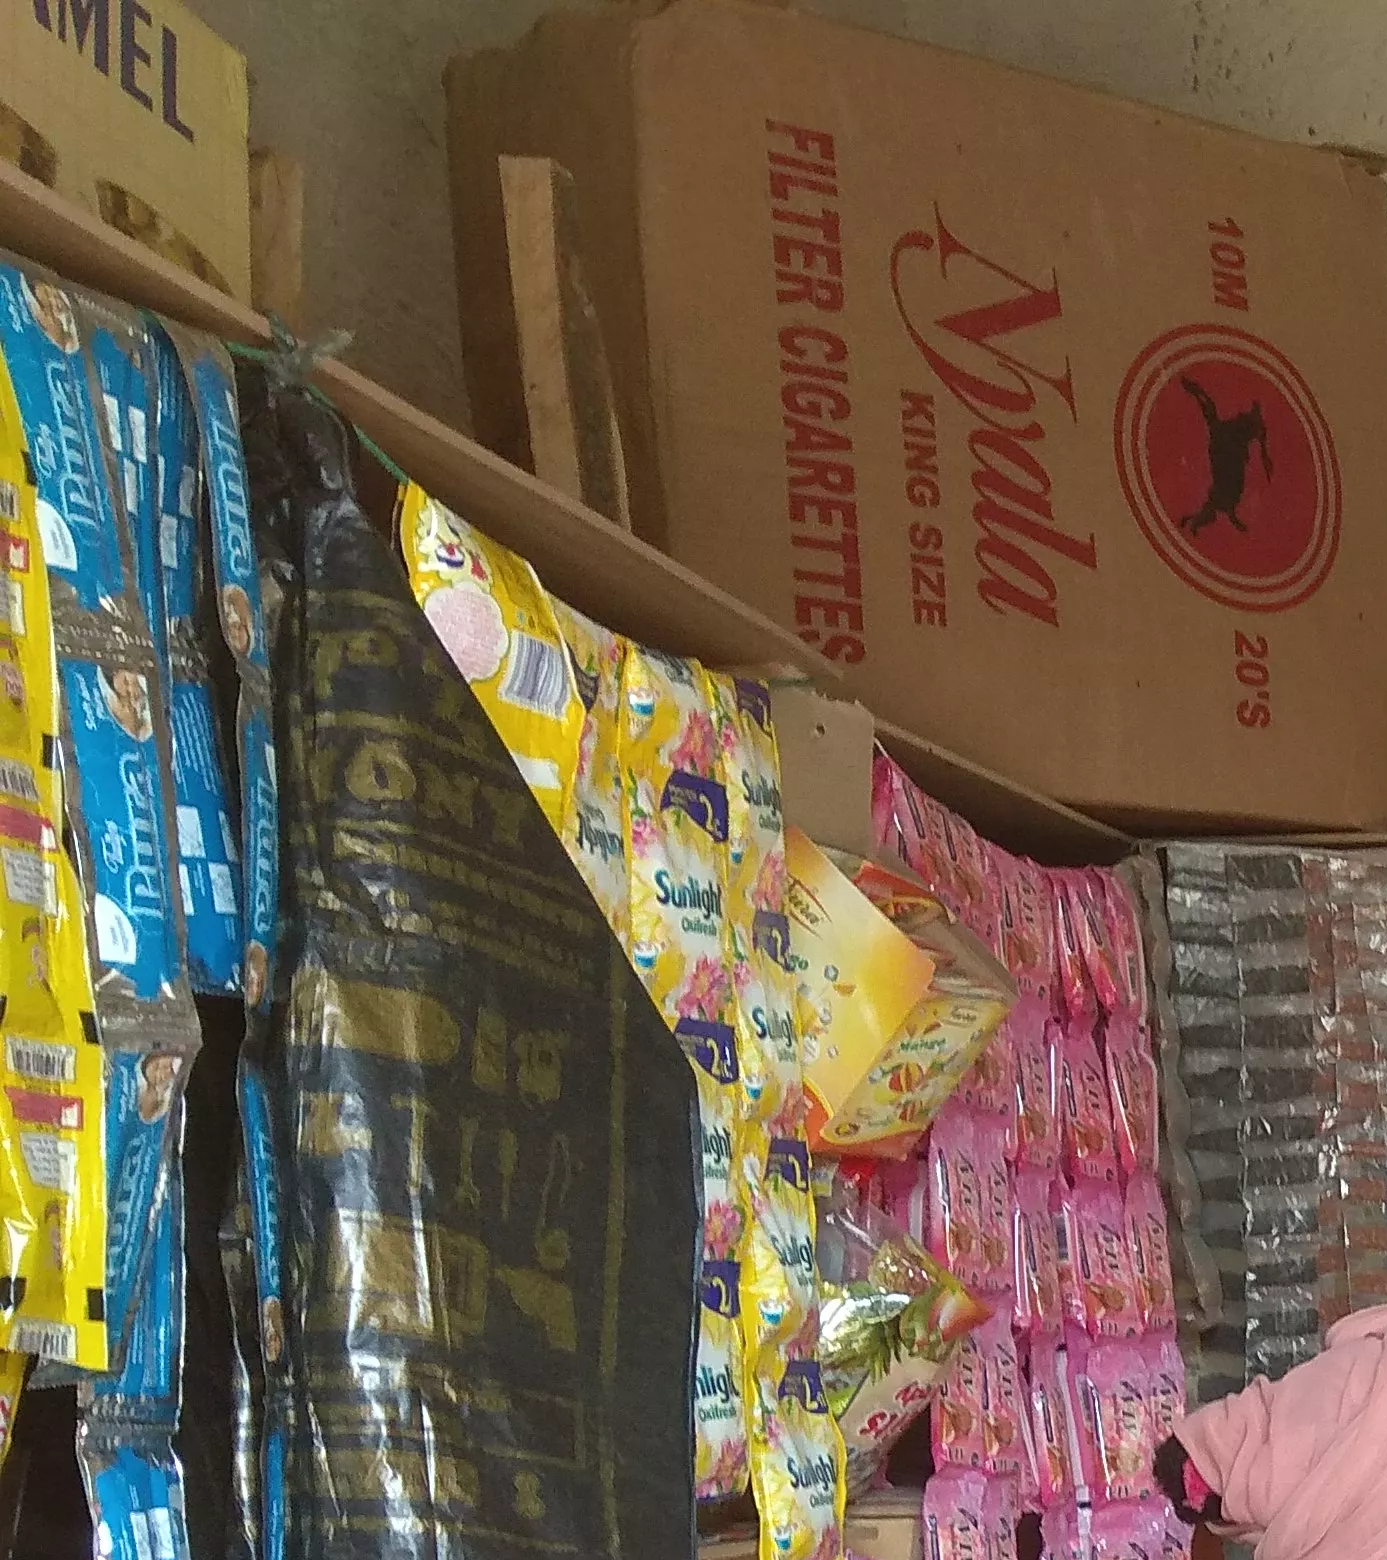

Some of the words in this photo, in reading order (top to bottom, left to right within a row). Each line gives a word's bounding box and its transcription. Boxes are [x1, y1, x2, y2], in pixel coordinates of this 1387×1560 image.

[765, 118, 845, 311] FILTER
[1208, 216, 1250, 311] 10M
[889, 200, 1098, 628] Nyala
[900, 389, 940, 509] KING
[777, 325, 867, 664] CIGARETTES
[909, 524, 947, 628] SIZE
[1234, 629, 1271, 729] 20'S
